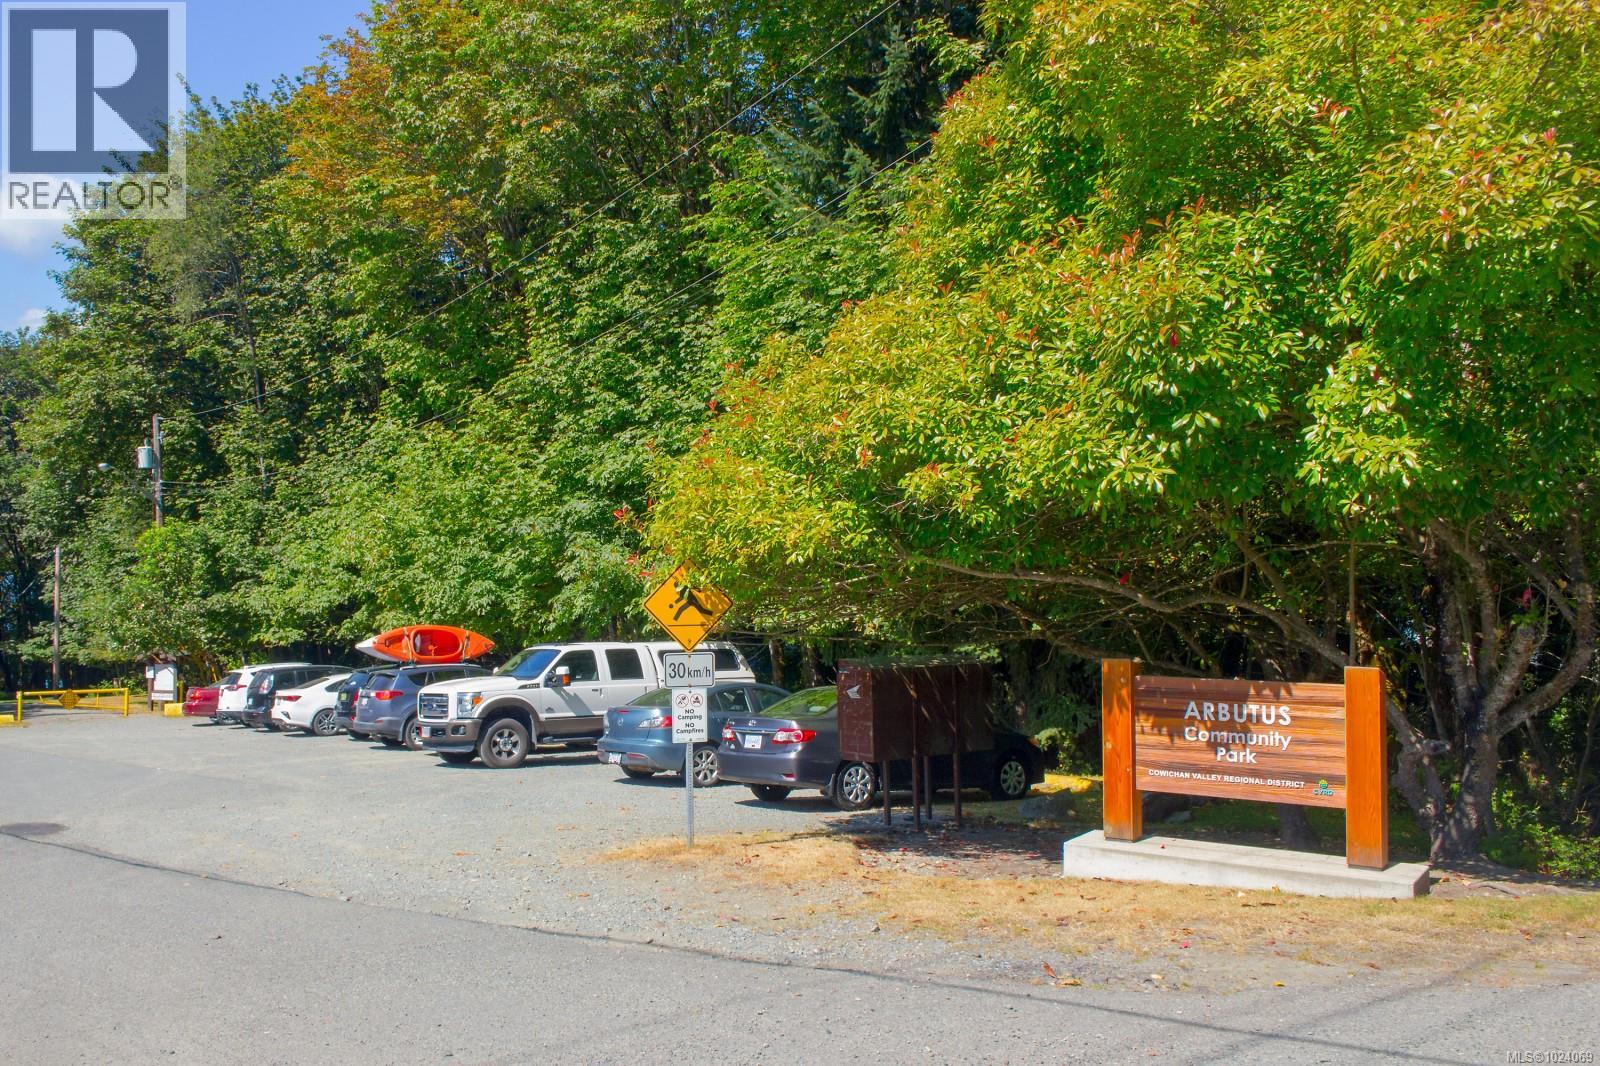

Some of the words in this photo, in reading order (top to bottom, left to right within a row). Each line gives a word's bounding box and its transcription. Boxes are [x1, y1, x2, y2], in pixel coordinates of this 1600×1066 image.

[668, 662, 686, 679] 30
[687, 666, 711, 678] km/h
[1183, 700, 1292, 726] ARBUTUS
[1183, 726, 1292, 751] Community
[1215, 747, 1257, 764] Park
[1148, 768, 1191, 779] COWICHAN
[1192, 772, 1222, 782] VALLEY
[1223, 775, 1265, 785] REGIONAL
[1267, 779, 1305, 788] DISTRICT
